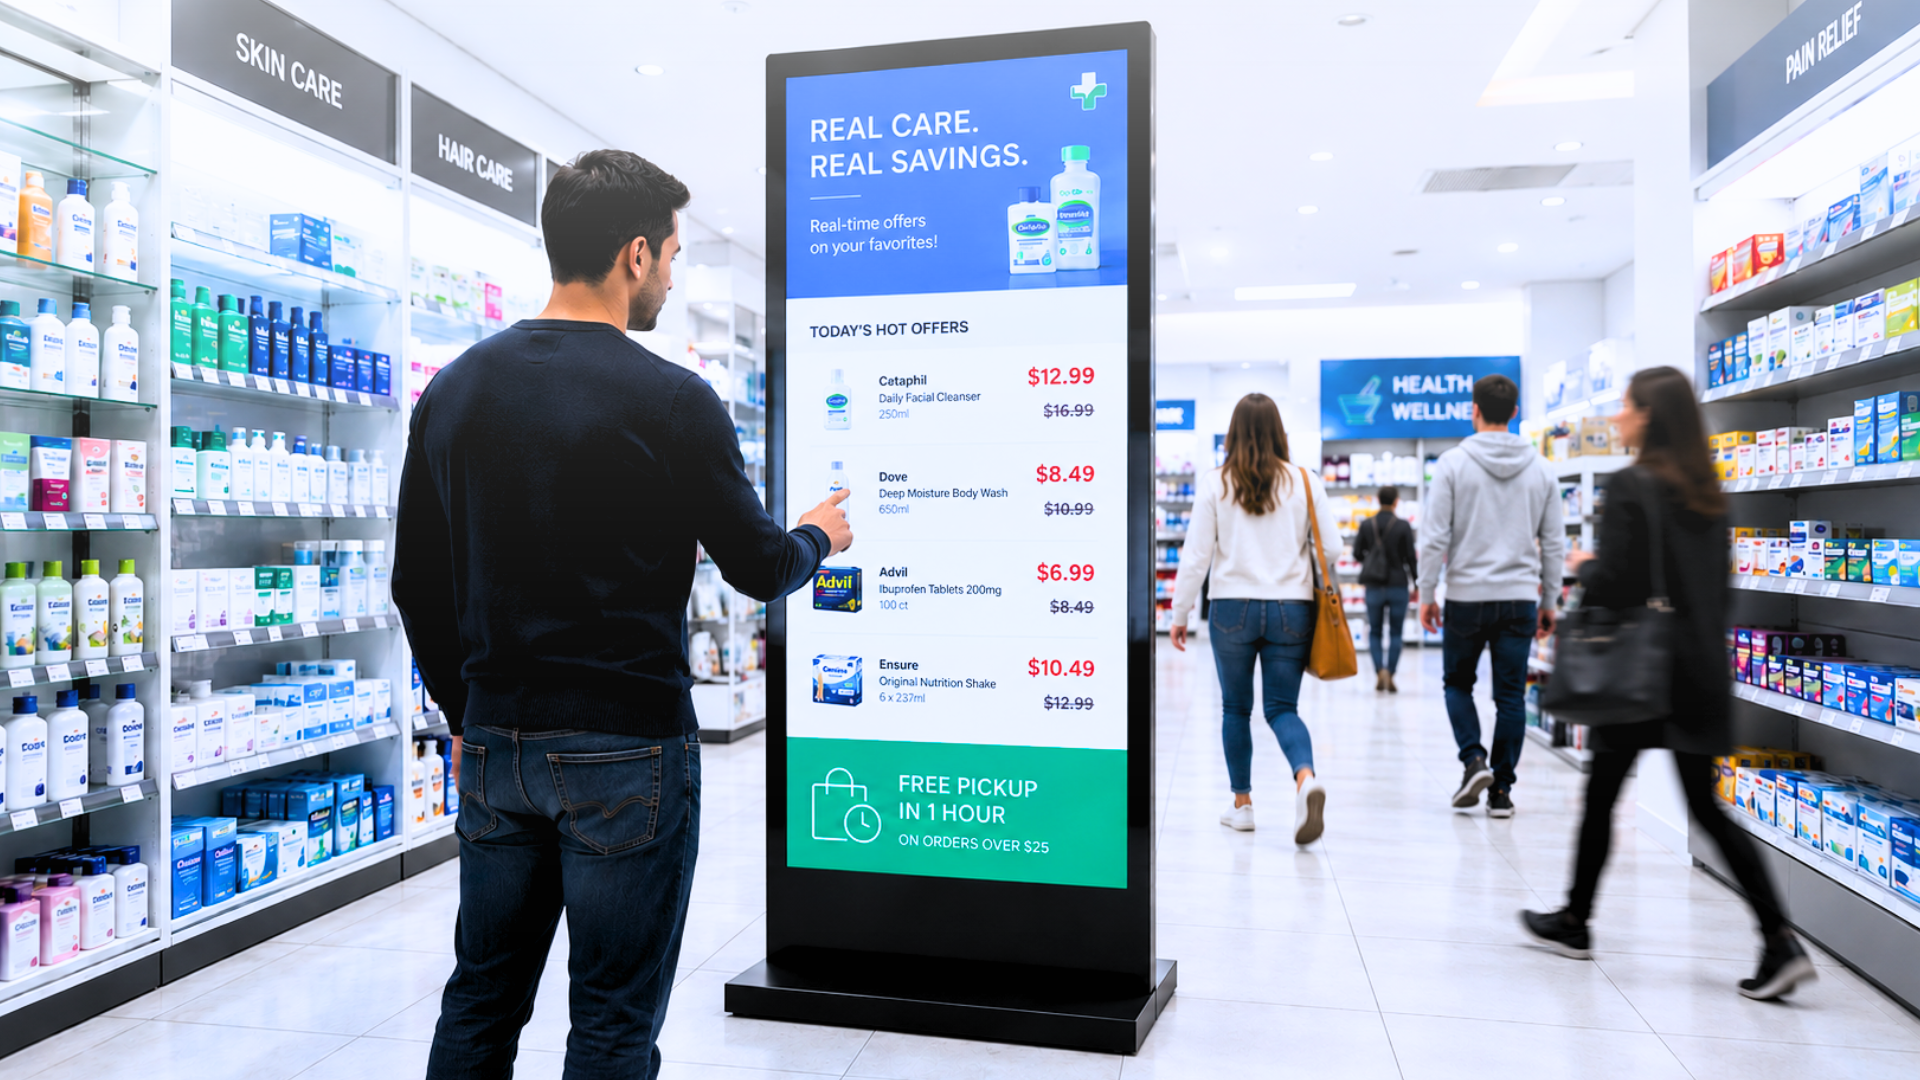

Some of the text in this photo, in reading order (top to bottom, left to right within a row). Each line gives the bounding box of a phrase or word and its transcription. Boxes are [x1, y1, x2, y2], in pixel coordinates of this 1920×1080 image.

[1786, 1, 1862, 84] PAIN RELIEF
[236, 33, 342, 109] SKIN CARE
[811, 110, 978, 142] REAL CARE.
[439, 134, 513, 192] HAIR CARE
[811, 143, 1028, 178] REAL SAVINGS.
[811, 214, 926, 232] Real-time offers
[810, 235, 937, 256] on your favorites!
[810, 321, 968, 337] TODAY'S HOT OFFERS
[879, 375, 926, 388] Cetaphil
[1029, 367, 1094, 387] $12.99
[1392, 374, 1473, 394] HEALTH
[879, 392, 981, 405] Daily Facial Cleanser
[879, 409, 909, 419] 250ml
[1044, 403, 1094, 418] $16.99
[1392, 402, 1473, 421] WELLNE
[879, 472, 907, 482] Dove
[1037, 464, 1094, 484] $8.49
[879, 488, 1008, 500] Deep Moisture Body Wash
[879, 504, 909, 514] 650ml
[1045, 501, 1094, 516] $10.99
[879, 567, 907, 577] Advil
[1037, 562, 1094, 582] $6.99
[879, 584, 1001, 597] Ibuprofen Tablets 200mg
[880, 600, 908, 610] 100 ct
[1050, 599, 1094, 614] $8.49
[880, 659, 918, 670] Ensure
[1029, 657, 1094, 677] $10.49
[879, 676, 996, 689] Original Nutrition Shake
[879, 692, 886, 702] 6
[896, 693, 925, 703] 237ml
[1044, 695, 1094, 710] $12.99
[900, 775, 1037, 797] FREE PICKUP
[900, 802, 1005, 824] IN 1 HOUR
[899, 834, 1049, 853] ON ORDERS OVER $25
